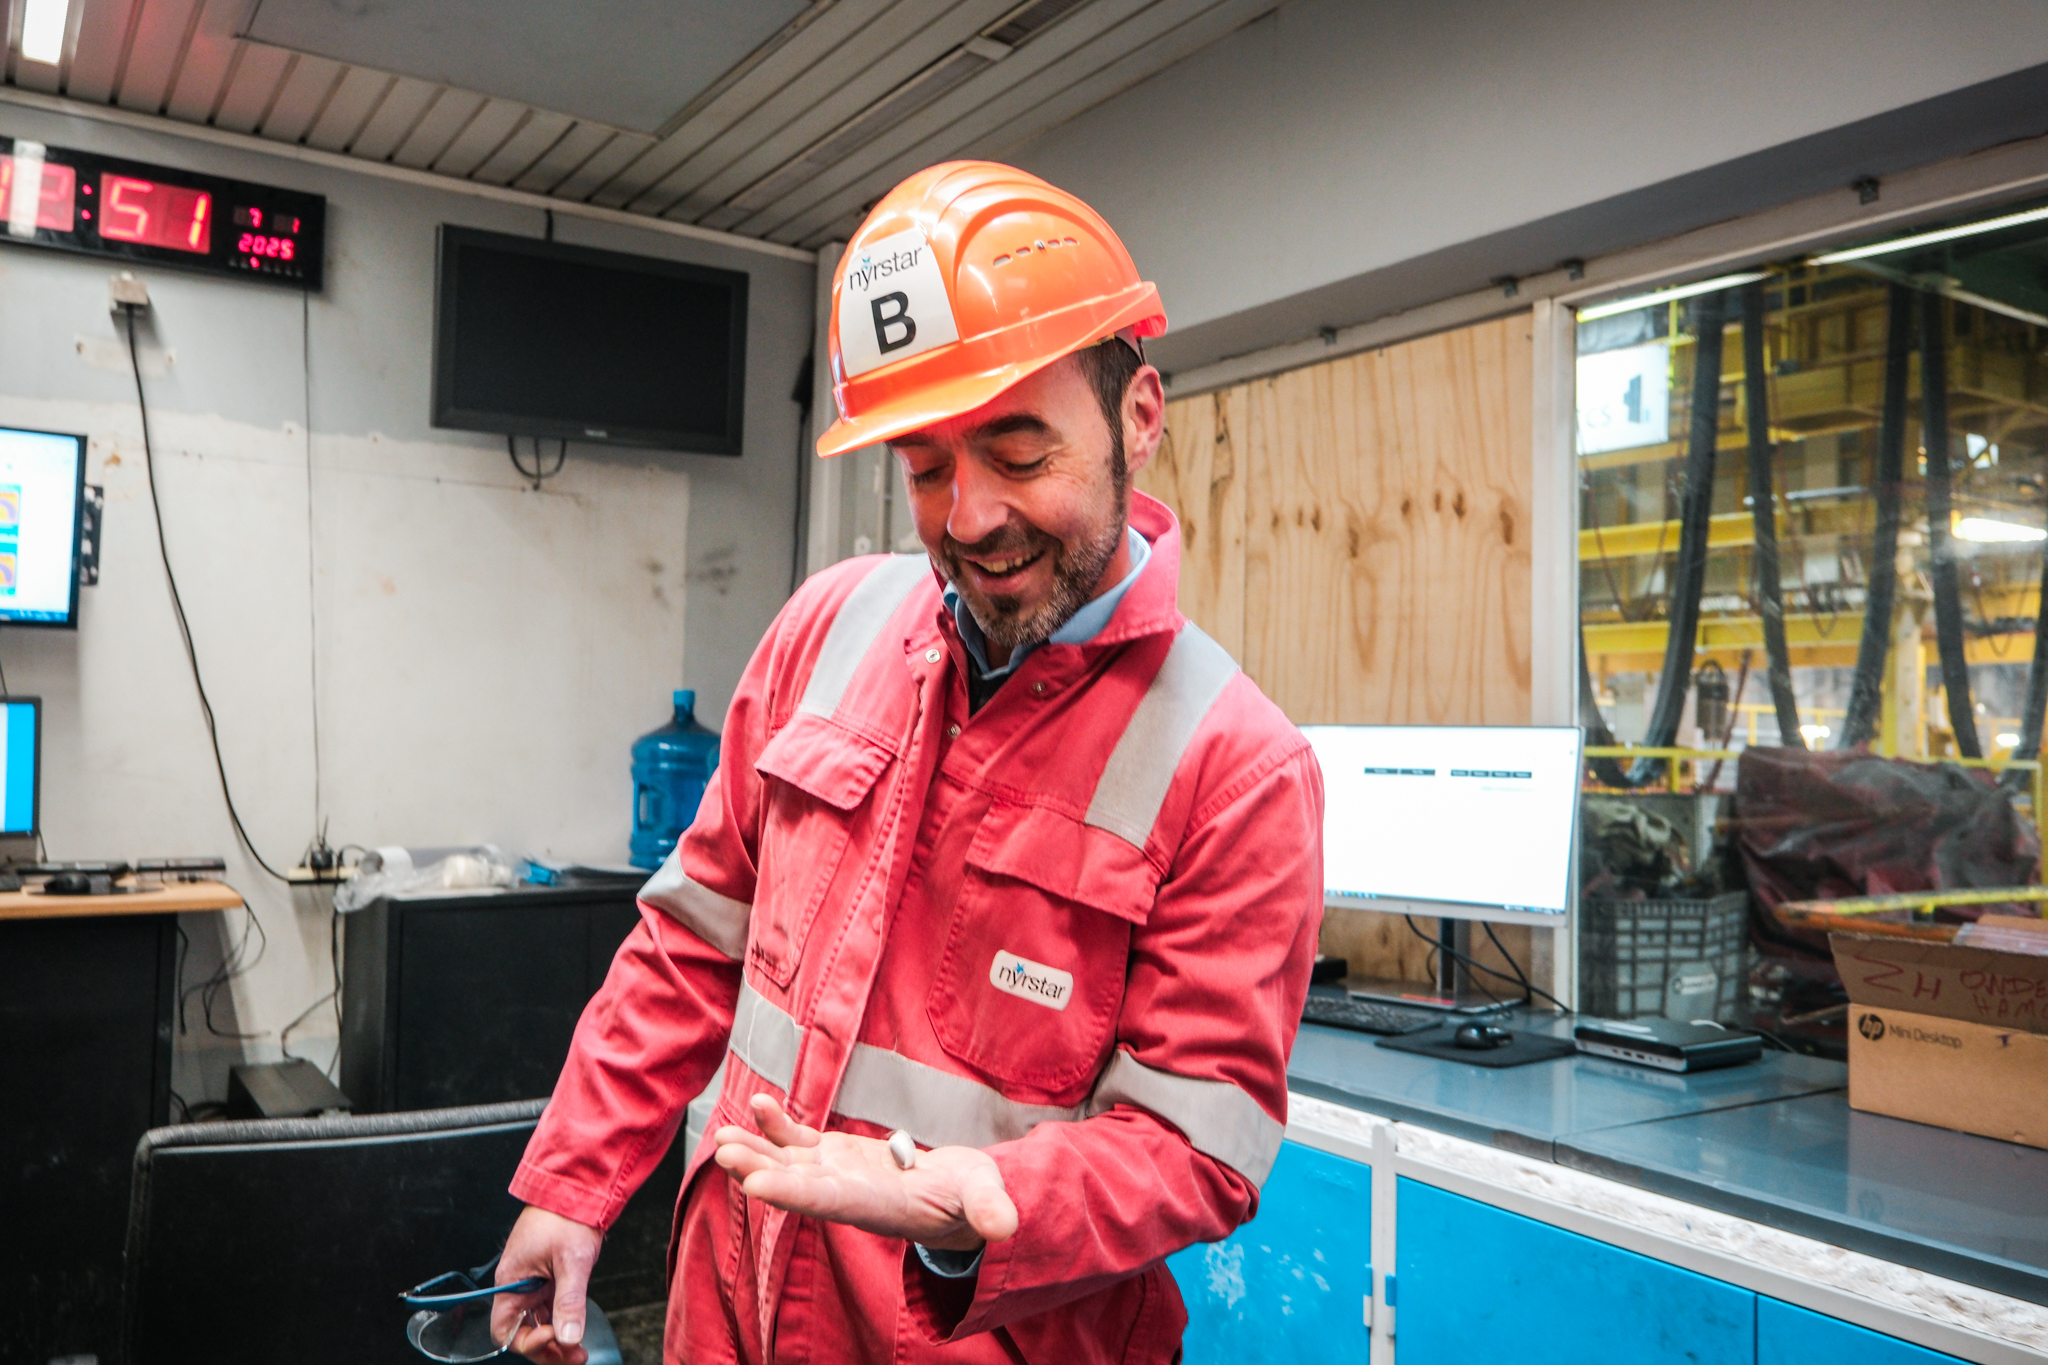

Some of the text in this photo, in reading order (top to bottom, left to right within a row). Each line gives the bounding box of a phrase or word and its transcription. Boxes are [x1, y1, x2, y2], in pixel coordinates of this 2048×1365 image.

[238, 232, 294, 260] 2025
[849, 246, 922, 292] nyrstar
[870, 290, 917, 355] B
[999, 963, 1066, 1000] nyrstar
[1889, 1024, 1912, 1040] Mini
[1913, 1028, 1963, 1049] Desktop
